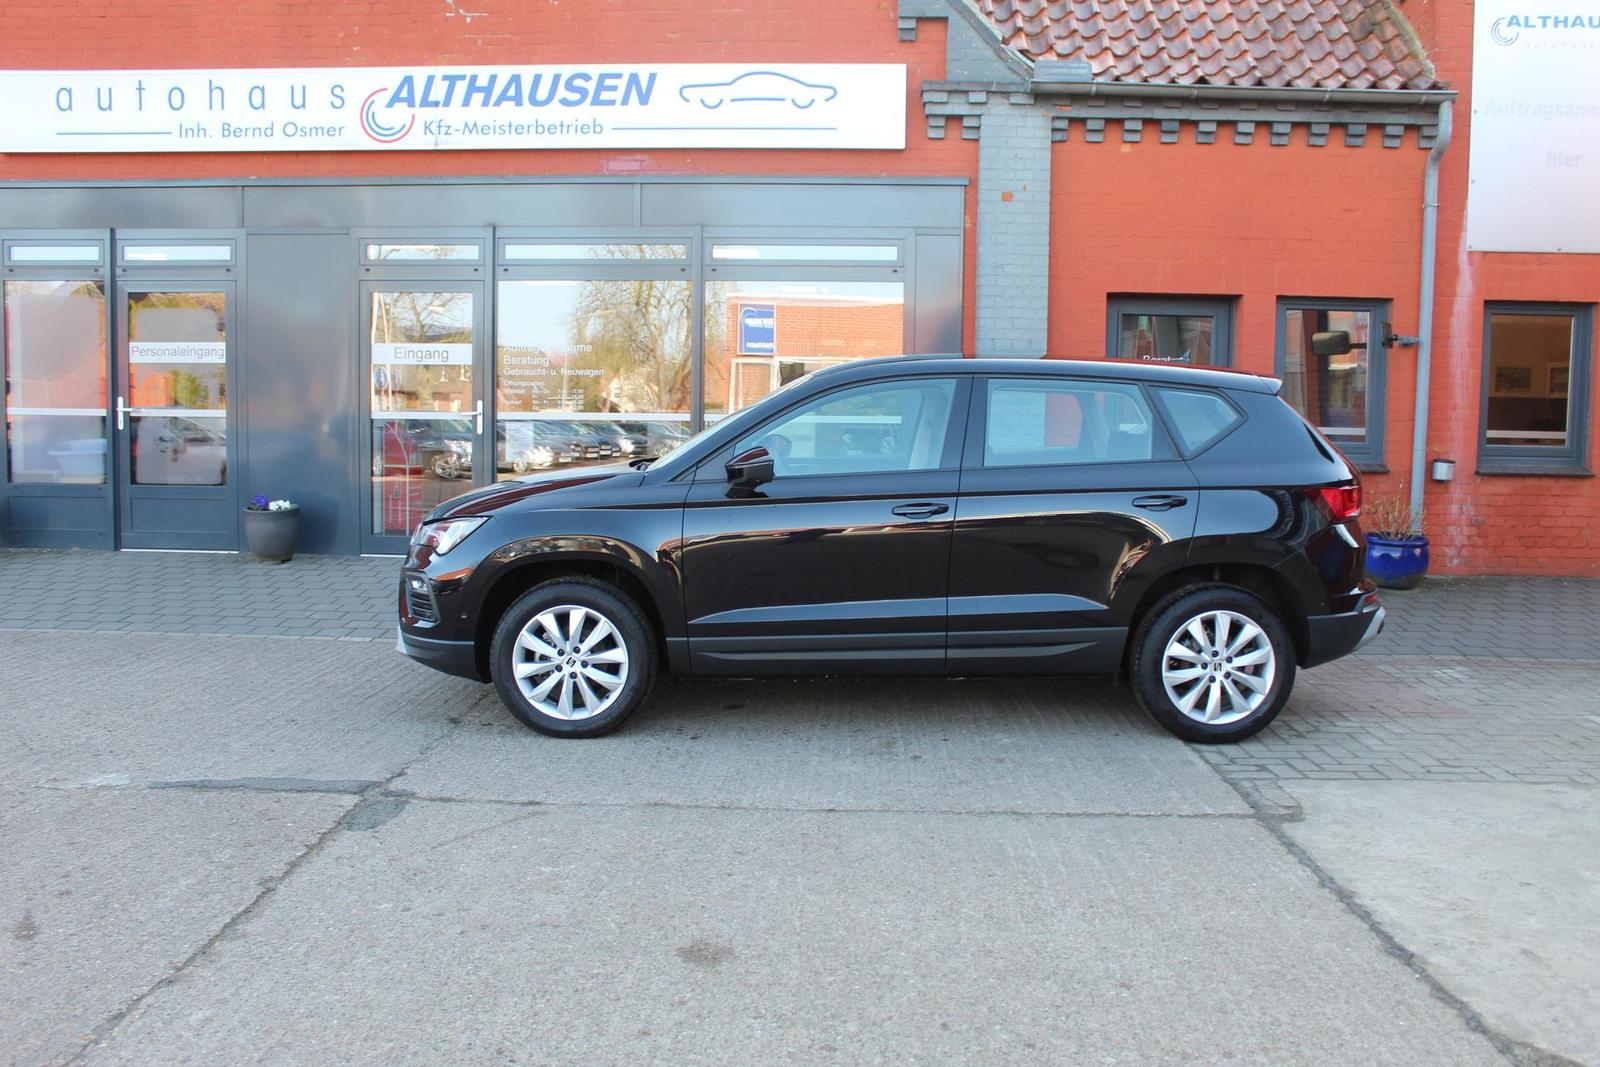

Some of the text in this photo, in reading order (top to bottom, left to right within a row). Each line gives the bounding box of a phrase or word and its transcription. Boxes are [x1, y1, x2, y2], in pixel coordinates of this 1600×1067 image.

[55, 72, 657, 112] autohaus ALTHAUSEN
[1485, 99, 1600, 122] Auftragsann
[178, 118, 604, 138] Inh. Bernd Osmer Kfz-Meisterbetrieb
[1546, 149, 1582, 168] hier
[131, 344, 225, 361] Personaleingang
[393, 345, 449, 363] Eingang
[503, 355, 550, 367] Beratung
[503, 367, 549, 376] Gebraucht-
[560, 367, 605, 378] Neuwagen
